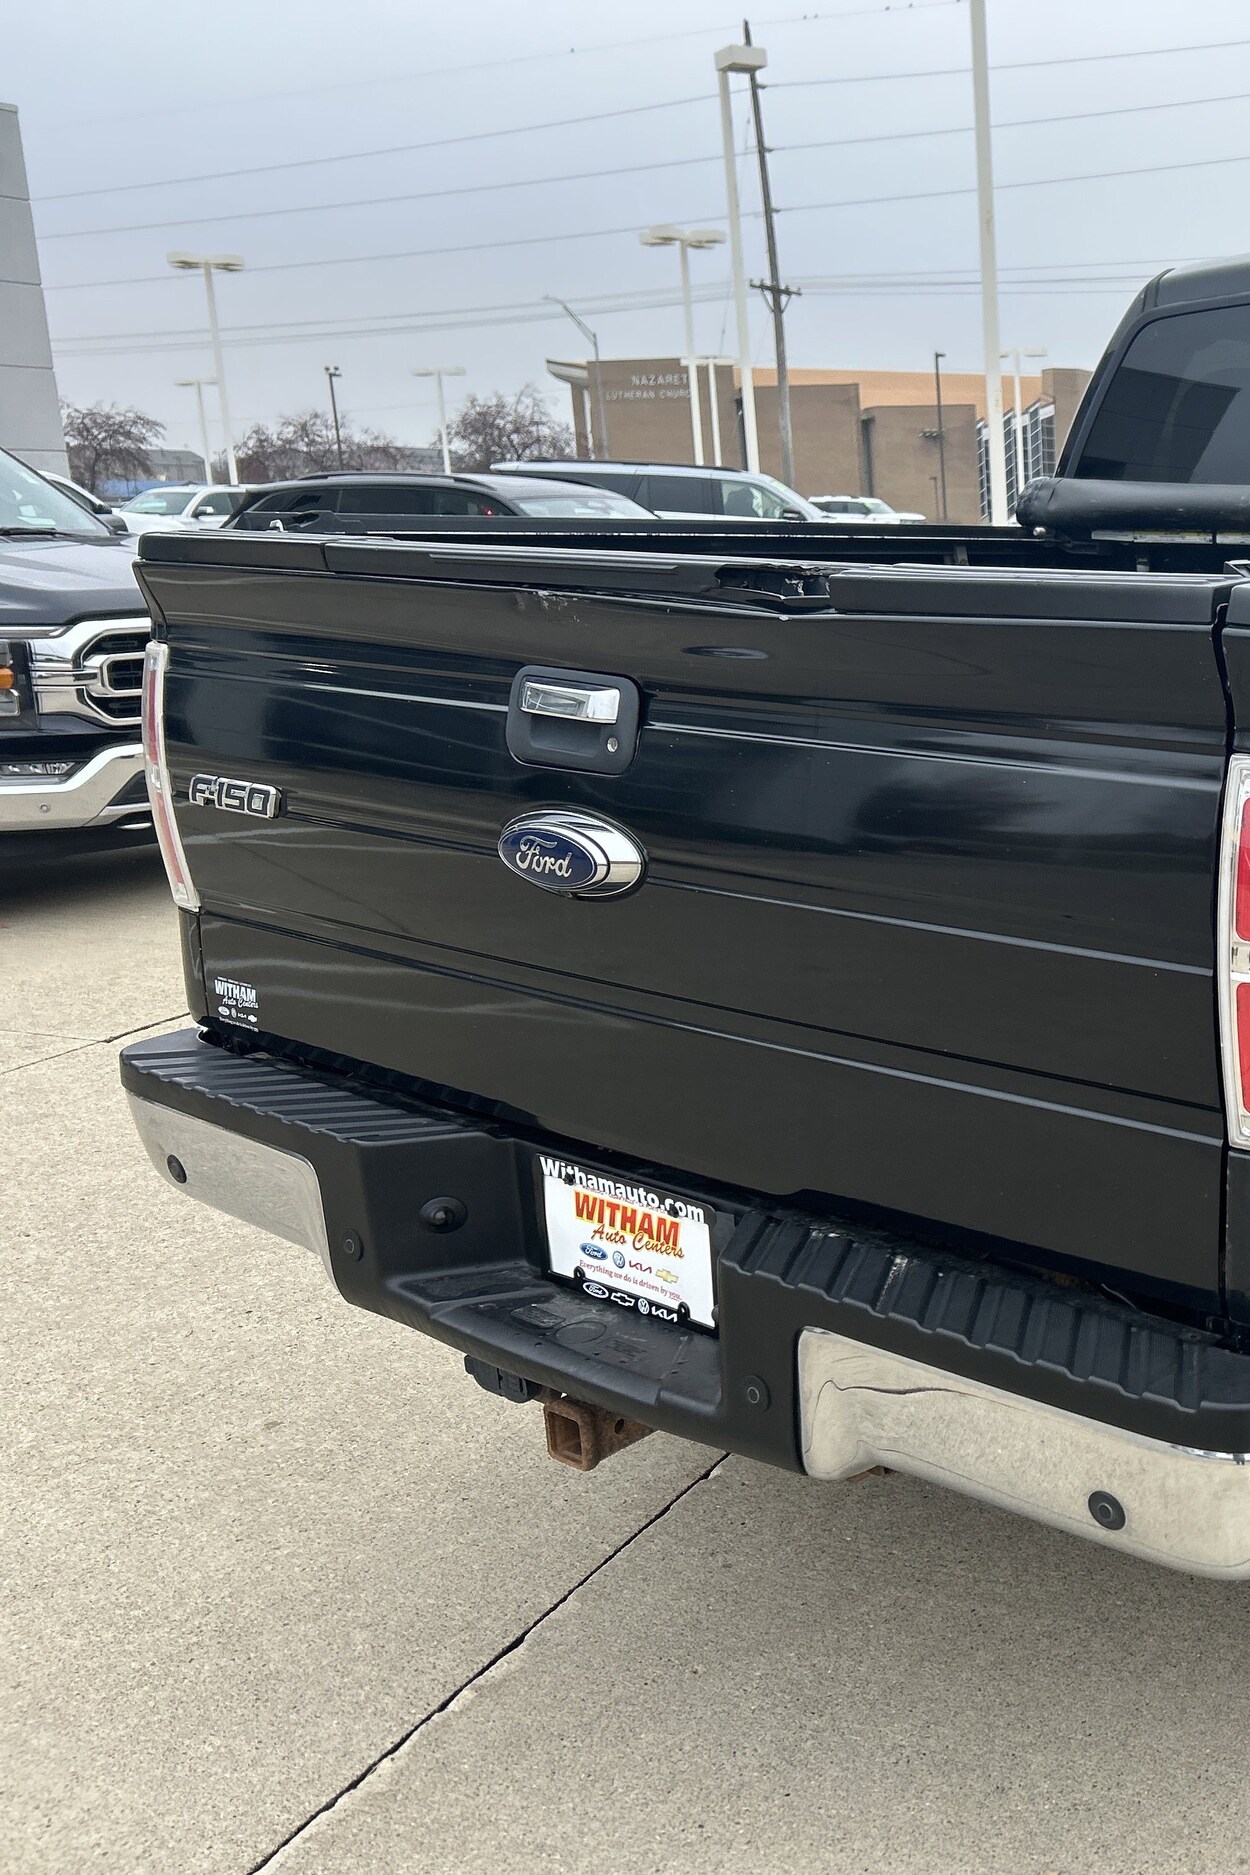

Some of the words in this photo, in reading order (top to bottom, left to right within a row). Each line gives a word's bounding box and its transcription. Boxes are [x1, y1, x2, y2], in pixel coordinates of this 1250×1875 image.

[631, 373, 688, 386] NAZARET
[605, 389, 655, 401] LUTHERAN
[659, 388, 691, 400] CHURC
[515, 834, 574, 878] Ford
[214, 979, 257, 1003] WITHAM
[222, 995, 237, 1006] Auto
[237, 996, 259, 1009] Centers
[574, 1191, 681, 1248] WITHAM
[582, 1244, 606, 1260] Ford
[590, 1223, 627, 1246] Auto
[632, 1231, 685, 1260] Centers
[579, 1259, 614, 1279] Everything
[613, 1272, 623, 1281] we
[623, 1274, 632, 1283] do
[632, 1276, 639, 1286] is
[638, 1279, 660, 1293] driven
[660, 1285, 669, 1297] by
